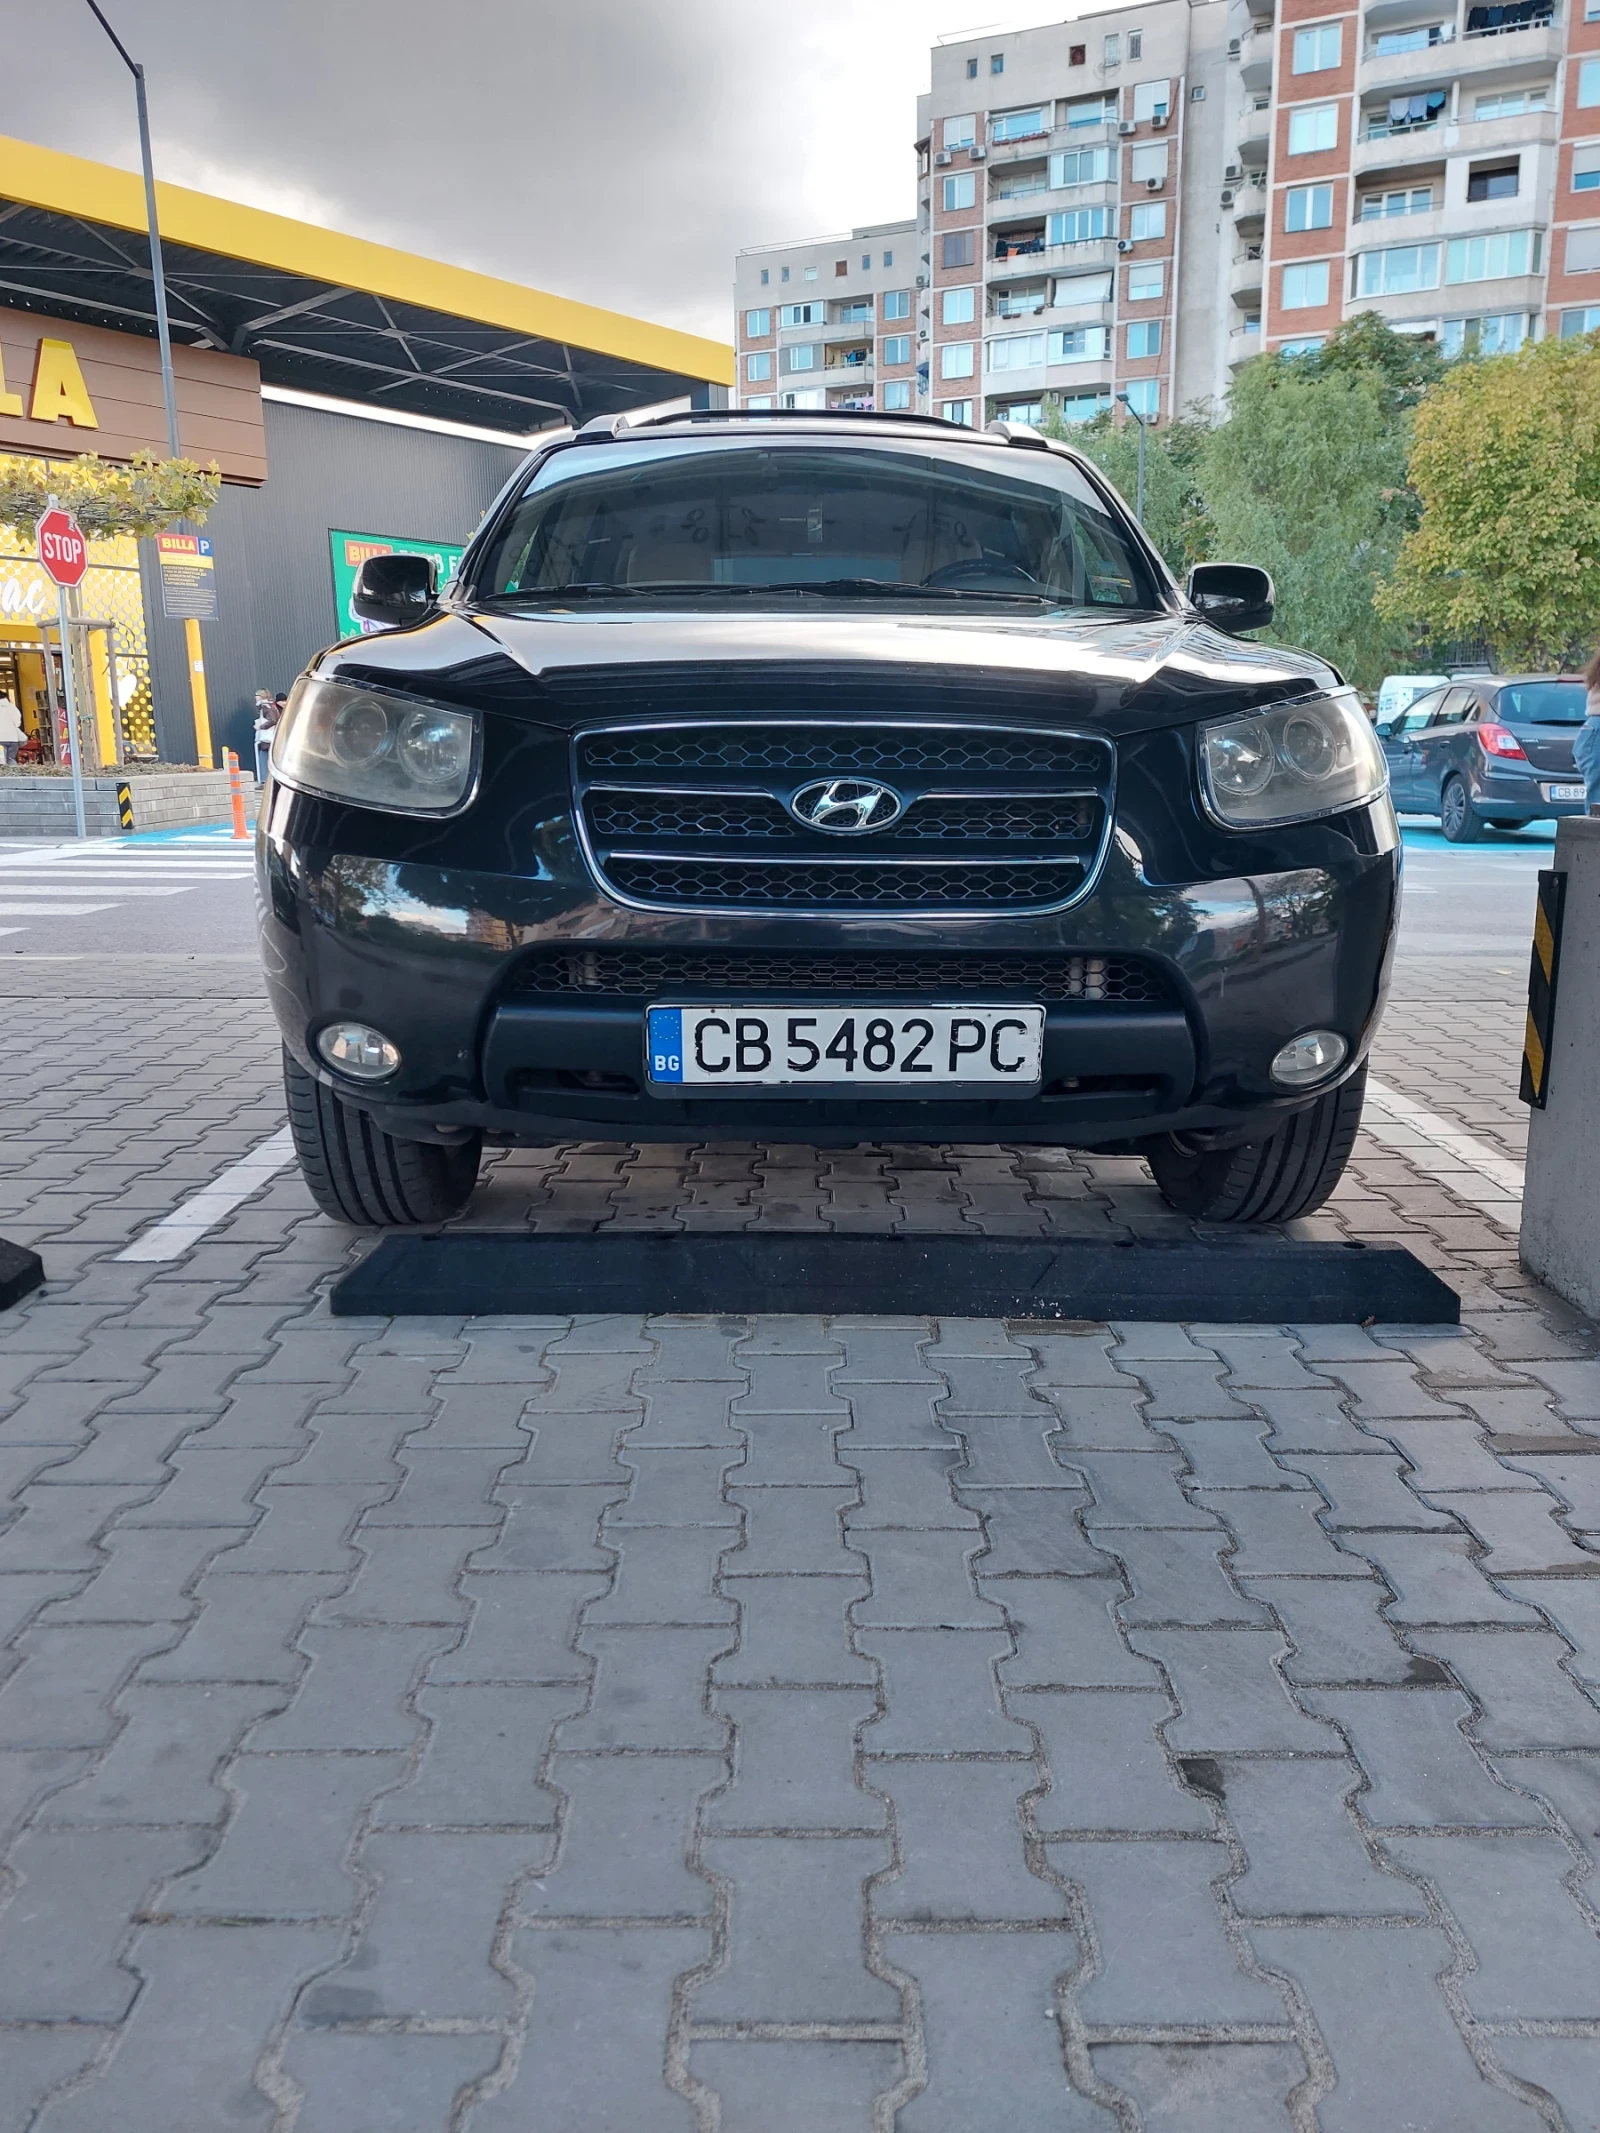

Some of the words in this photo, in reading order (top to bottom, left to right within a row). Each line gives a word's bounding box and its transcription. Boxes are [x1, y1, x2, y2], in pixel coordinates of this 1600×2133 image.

[43, 531, 82, 564] STOP
[161, 537, 196, 551] BILLA
[200, 540, 210, 553] P
[694, 1017, 772, 1073] CB
[787, 1018, 934, 1073] 5482
[948, 1018, 1028, 1073] PC
[654, 1055, 680, 1071] BG
